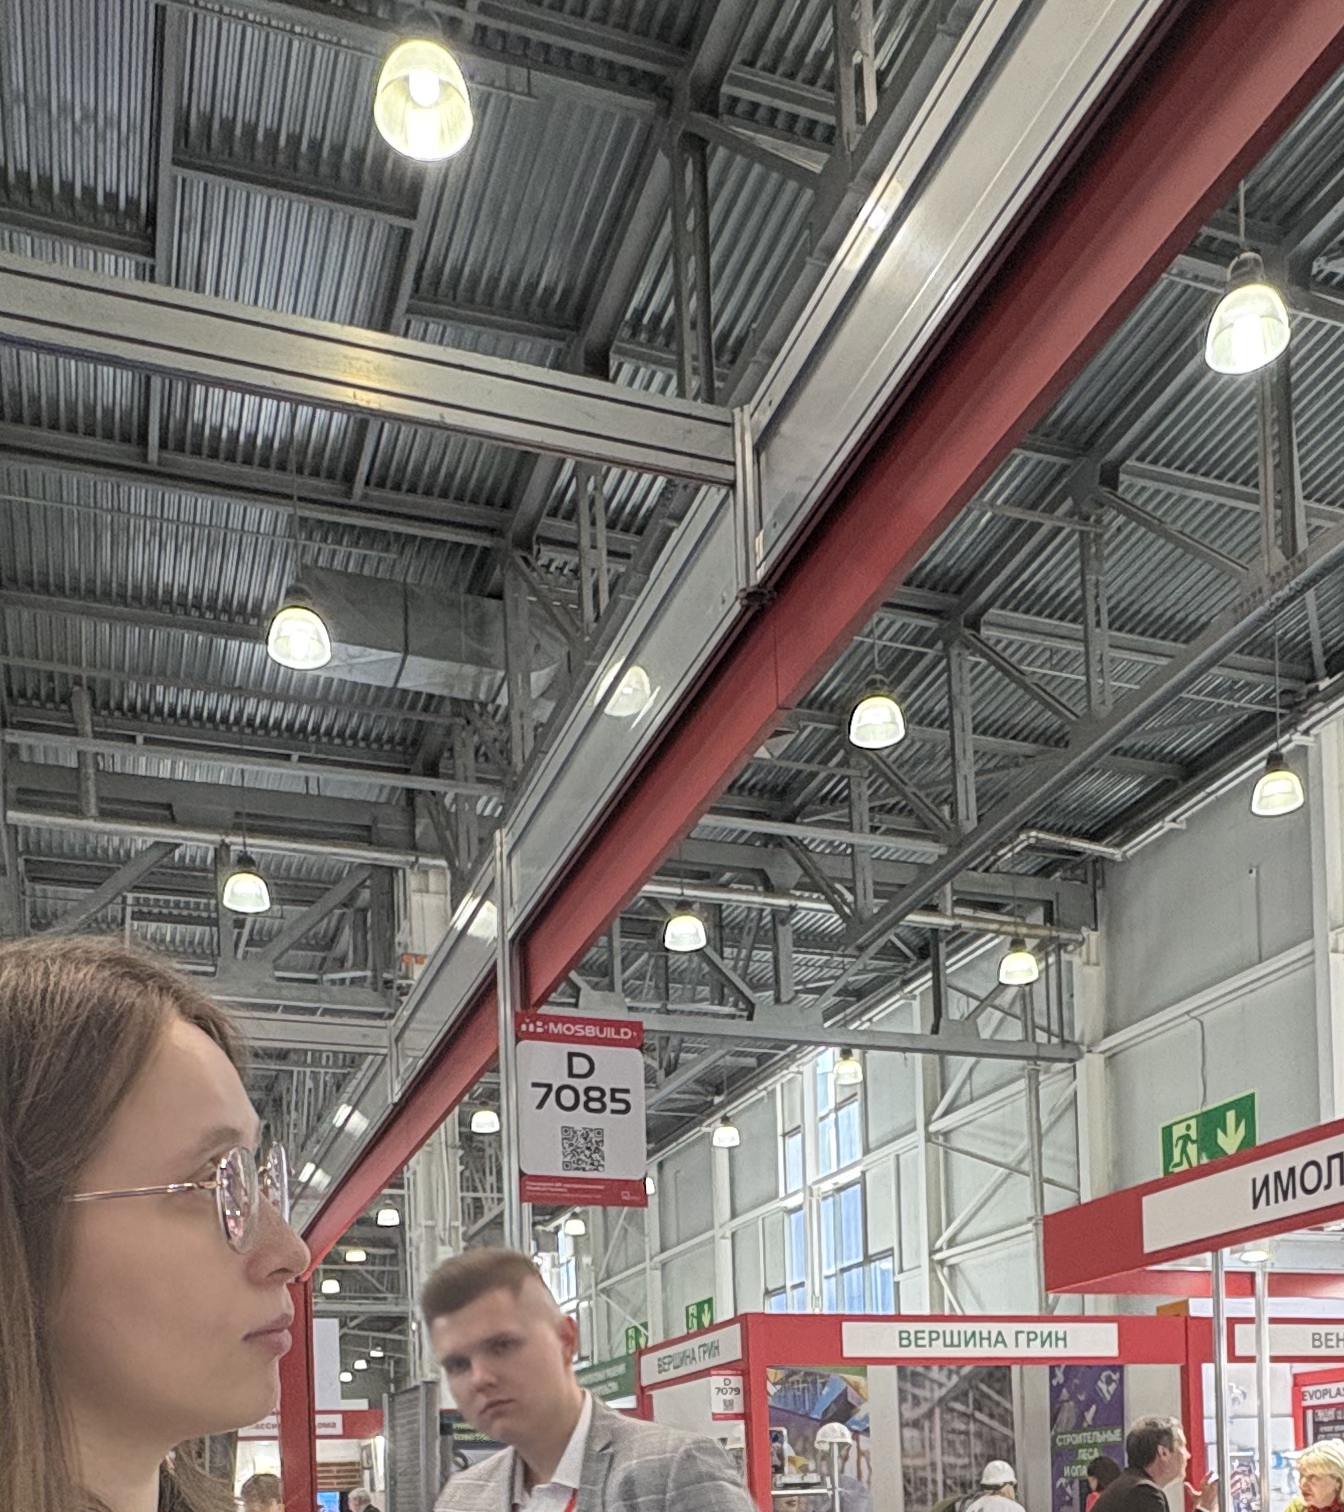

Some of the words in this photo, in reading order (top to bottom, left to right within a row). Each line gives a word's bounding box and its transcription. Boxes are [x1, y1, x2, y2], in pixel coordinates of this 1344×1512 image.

[548, 1022, 633, 1040] MOSBUILD
[566, 1051, 596, 1079] D
[530, 1081, 632, 1115] 7085
[898, 1329, 1008, 1349] ВЕРШИНА
[1014, 1330, 1068, 1348] ГРИН
[657, 1346, 697, 1374] ВЕРШИНА
[697, 1338, 720, 1365] ГРИН
[714, 1386, 741, 1396] 7079
[723, 1378, 732, 1387] D
